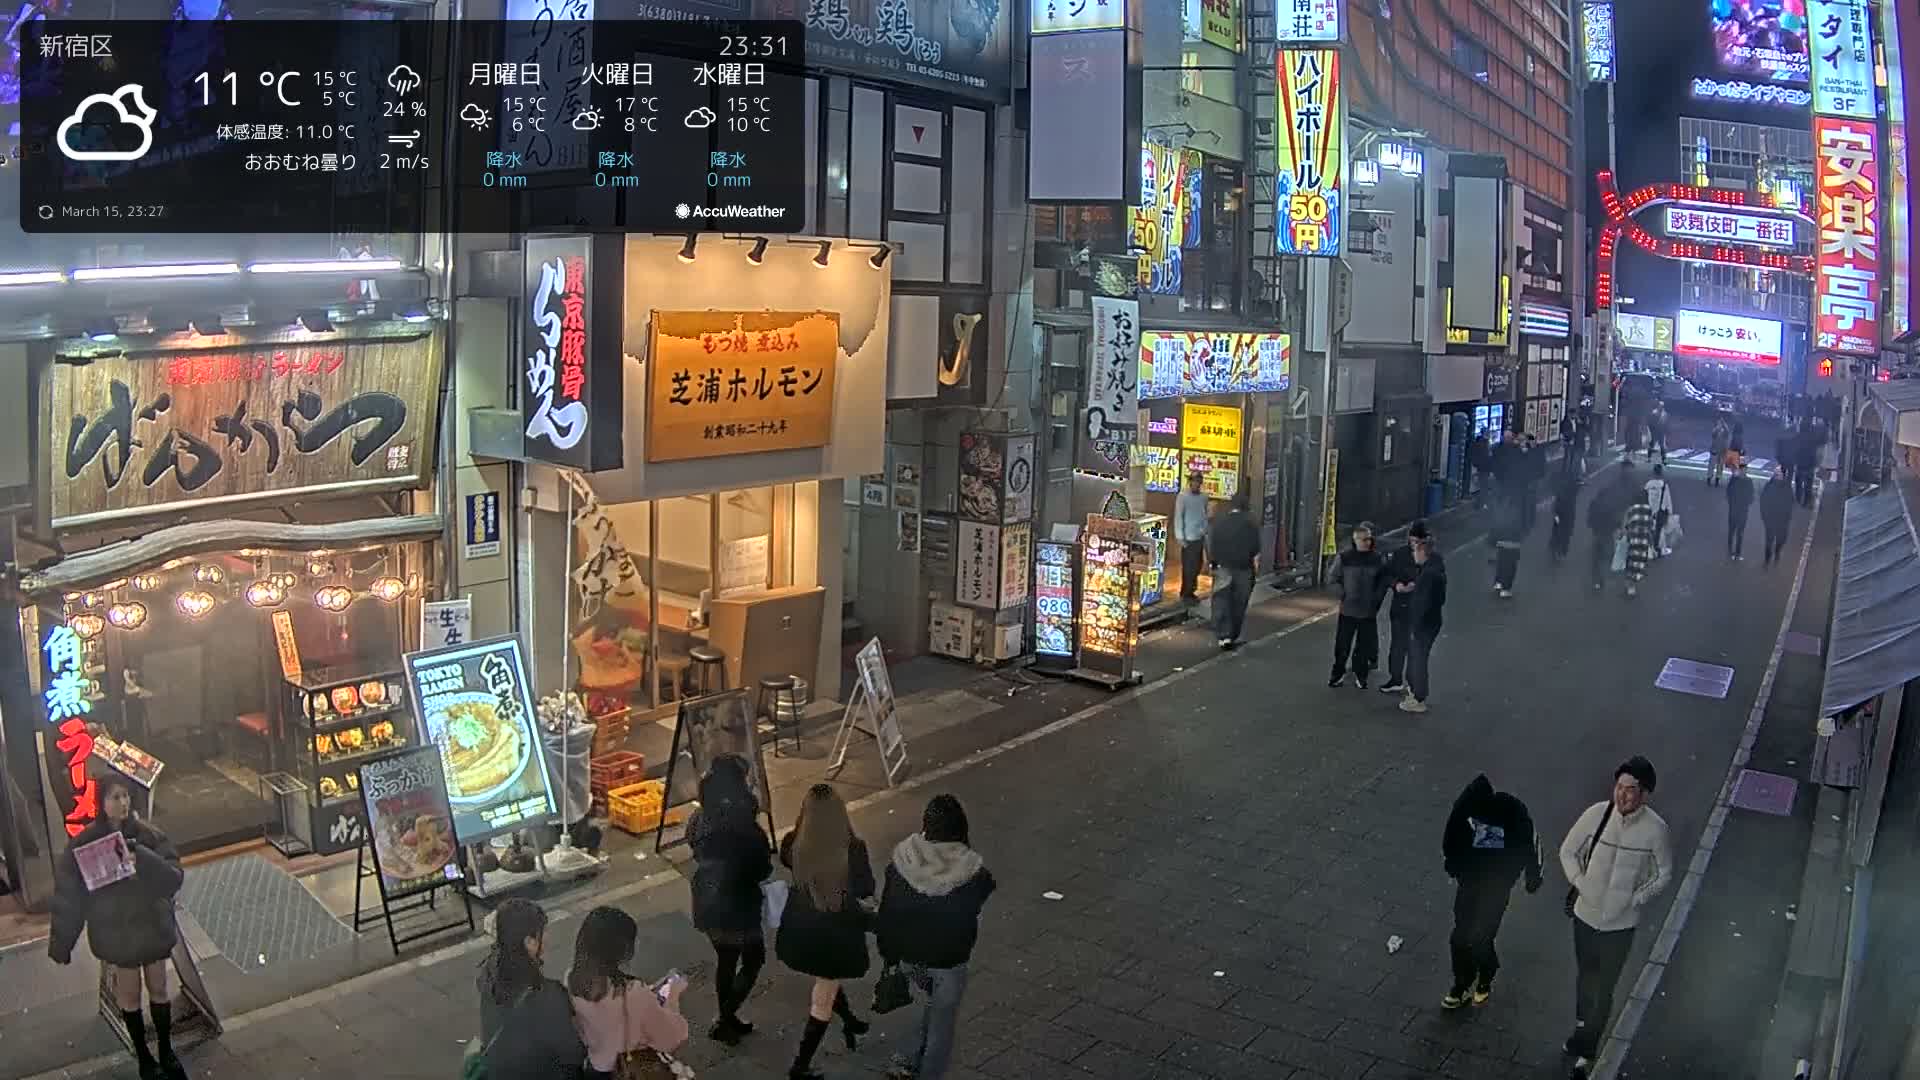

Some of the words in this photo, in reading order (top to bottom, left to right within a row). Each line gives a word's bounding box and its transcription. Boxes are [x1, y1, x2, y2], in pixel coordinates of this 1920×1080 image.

[1589, 63, 1610, 79] 7F
[1833, 97, 1856, 111] 3F
[1296, 53, 1322, 189] ハイボール
[1670, 211, 1789, 242] 歌舞伎町一番街
[1820, 124, 1877, 330] 安楽亭
[561, 256, 585, 400] 東京豚骨
[1818, 332, 1837, 348] 2F
[1107, 309, 1137, 412] お好み焼き
[669, 367, 824, 406] 芝浦ホルモン
[704, 419, 789, 440] 創業昭和二十九年
[1111, 430, 1136, 442] B1F
[1040, 598, 1069, 613] 980
[44, 626, 91, 721] 角煮
[416, 663, 462, 684] TOKYO
[420, 676, 465, 696] RAMEN
